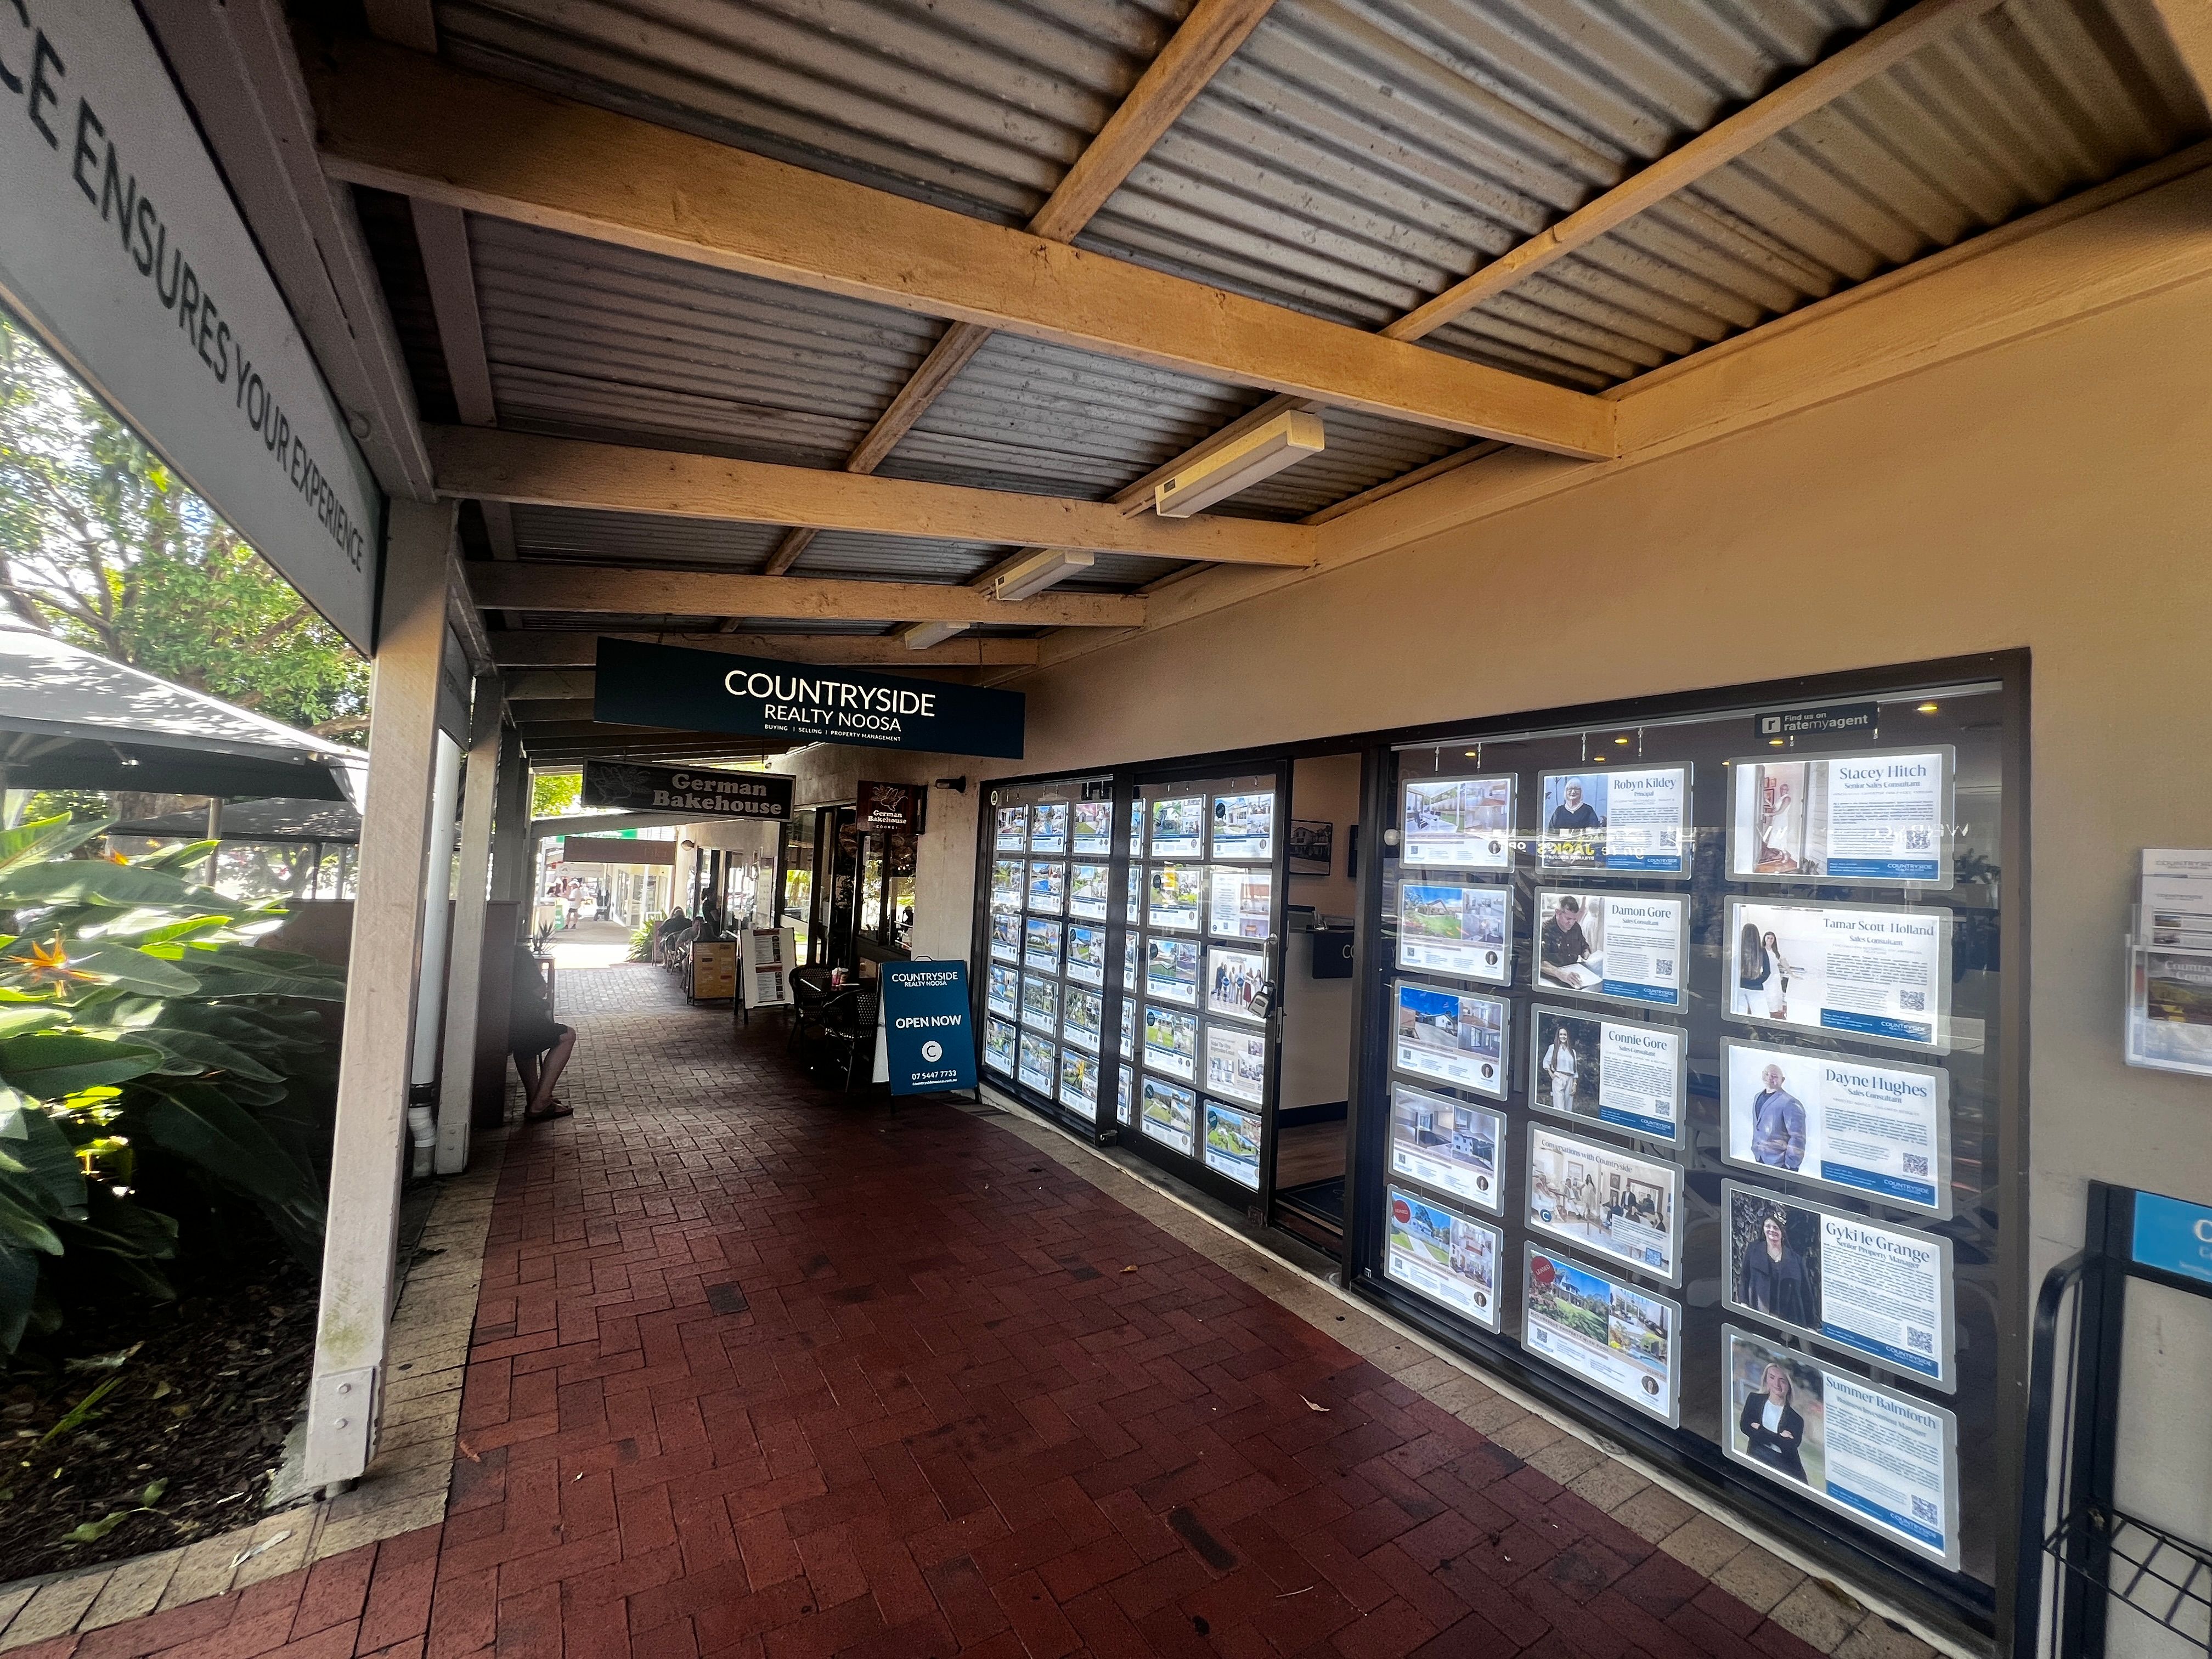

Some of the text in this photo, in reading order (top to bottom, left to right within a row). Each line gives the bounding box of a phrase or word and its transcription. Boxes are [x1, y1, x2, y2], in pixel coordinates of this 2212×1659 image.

[72, 97, 230, 385] ENSURES
[235, 344, 290, 472] YOUR
[290, 436, 364, 573] EXPERIENCE
[725, 670, 936, 717] COUNTRYSIDE
[765, 704, 901, 732] REALTY NOOSA
[1784, 715, 1868, 731] ratemyagent
[861, 733, 901, 742] MANAGEMENT
[1839, 765, 1926, 781] Stacey Hitch
[672, 774, 767, 796] German
[1613, 777, 1677, 791] Robyn Kildey
[652, 790, 782, 815] Bakehouse
[868, 815, 907, 824] Bakehouse
[873, 810, 902, 818] German
[1612, 905, 1672, 918] Damon Gore
[1823, 918, 1855, 929] Tamar
[1867, 937, 1904, 946] Consultant
[891, 972, 958, 982] COUNTRYSIDE
[895, 1015, 962, 1029] OPEN NOW
[1880, 1021, 1926, 1031] COUNTRYSIDE
[1609, 1030, 1667, 1051] Connie Gore
[1630, 1047, 1656, 1057] Consultant
[922, 1071, 939, 1080] 5447
[1826, 1069, 1928, 1097] Dayne Hughes
[1848, 1088, 1903, 1104] Sales Consultant
[1640, 1118, 1672, 1130] COUNTRYSIDE
[1542, 1139, 1633, 1173] Conversations with Countryside
[1883, 1179, 1929, 1194] COUNTRYSIDE
[1826, 1222, 1930, 1263] Gyki le Grange
[1837, 1239, 1920, 1269] Senior Property Manager
[1536, 1263, 1550, 1276] LEASED
[1885, 1345, 1932, 1368] COUNTRYSIDE
[1826, 1376, 1937, 1430] Summer Balmforth
[1899, 1420, 1927, 1437] Manager
